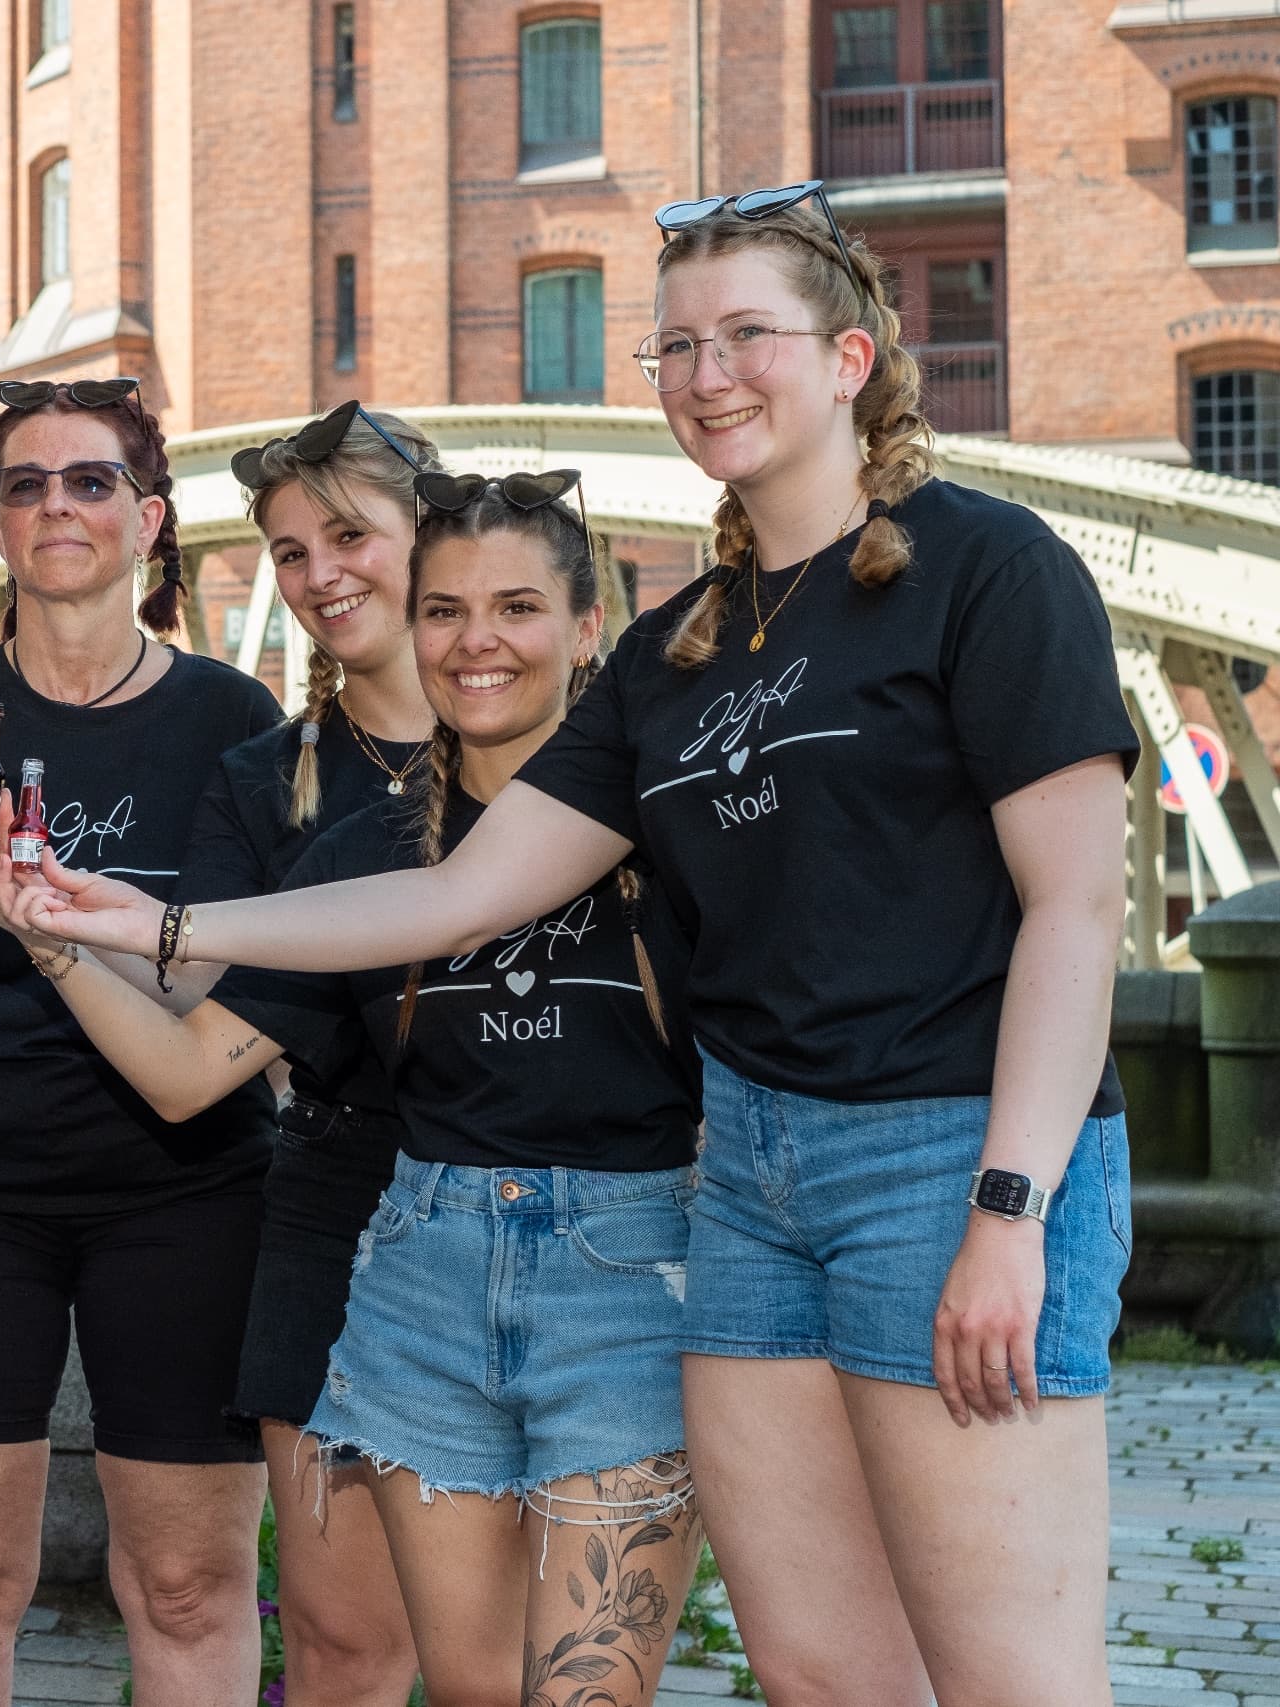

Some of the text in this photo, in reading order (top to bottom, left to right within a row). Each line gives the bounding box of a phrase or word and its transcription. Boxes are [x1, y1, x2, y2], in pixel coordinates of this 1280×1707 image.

[679, 657, 808, 762] JGA
[40, 795, 137, 865] GA
[711, 774, 780, 830] Noél
[479, 1004, 564, 1042] Noél
